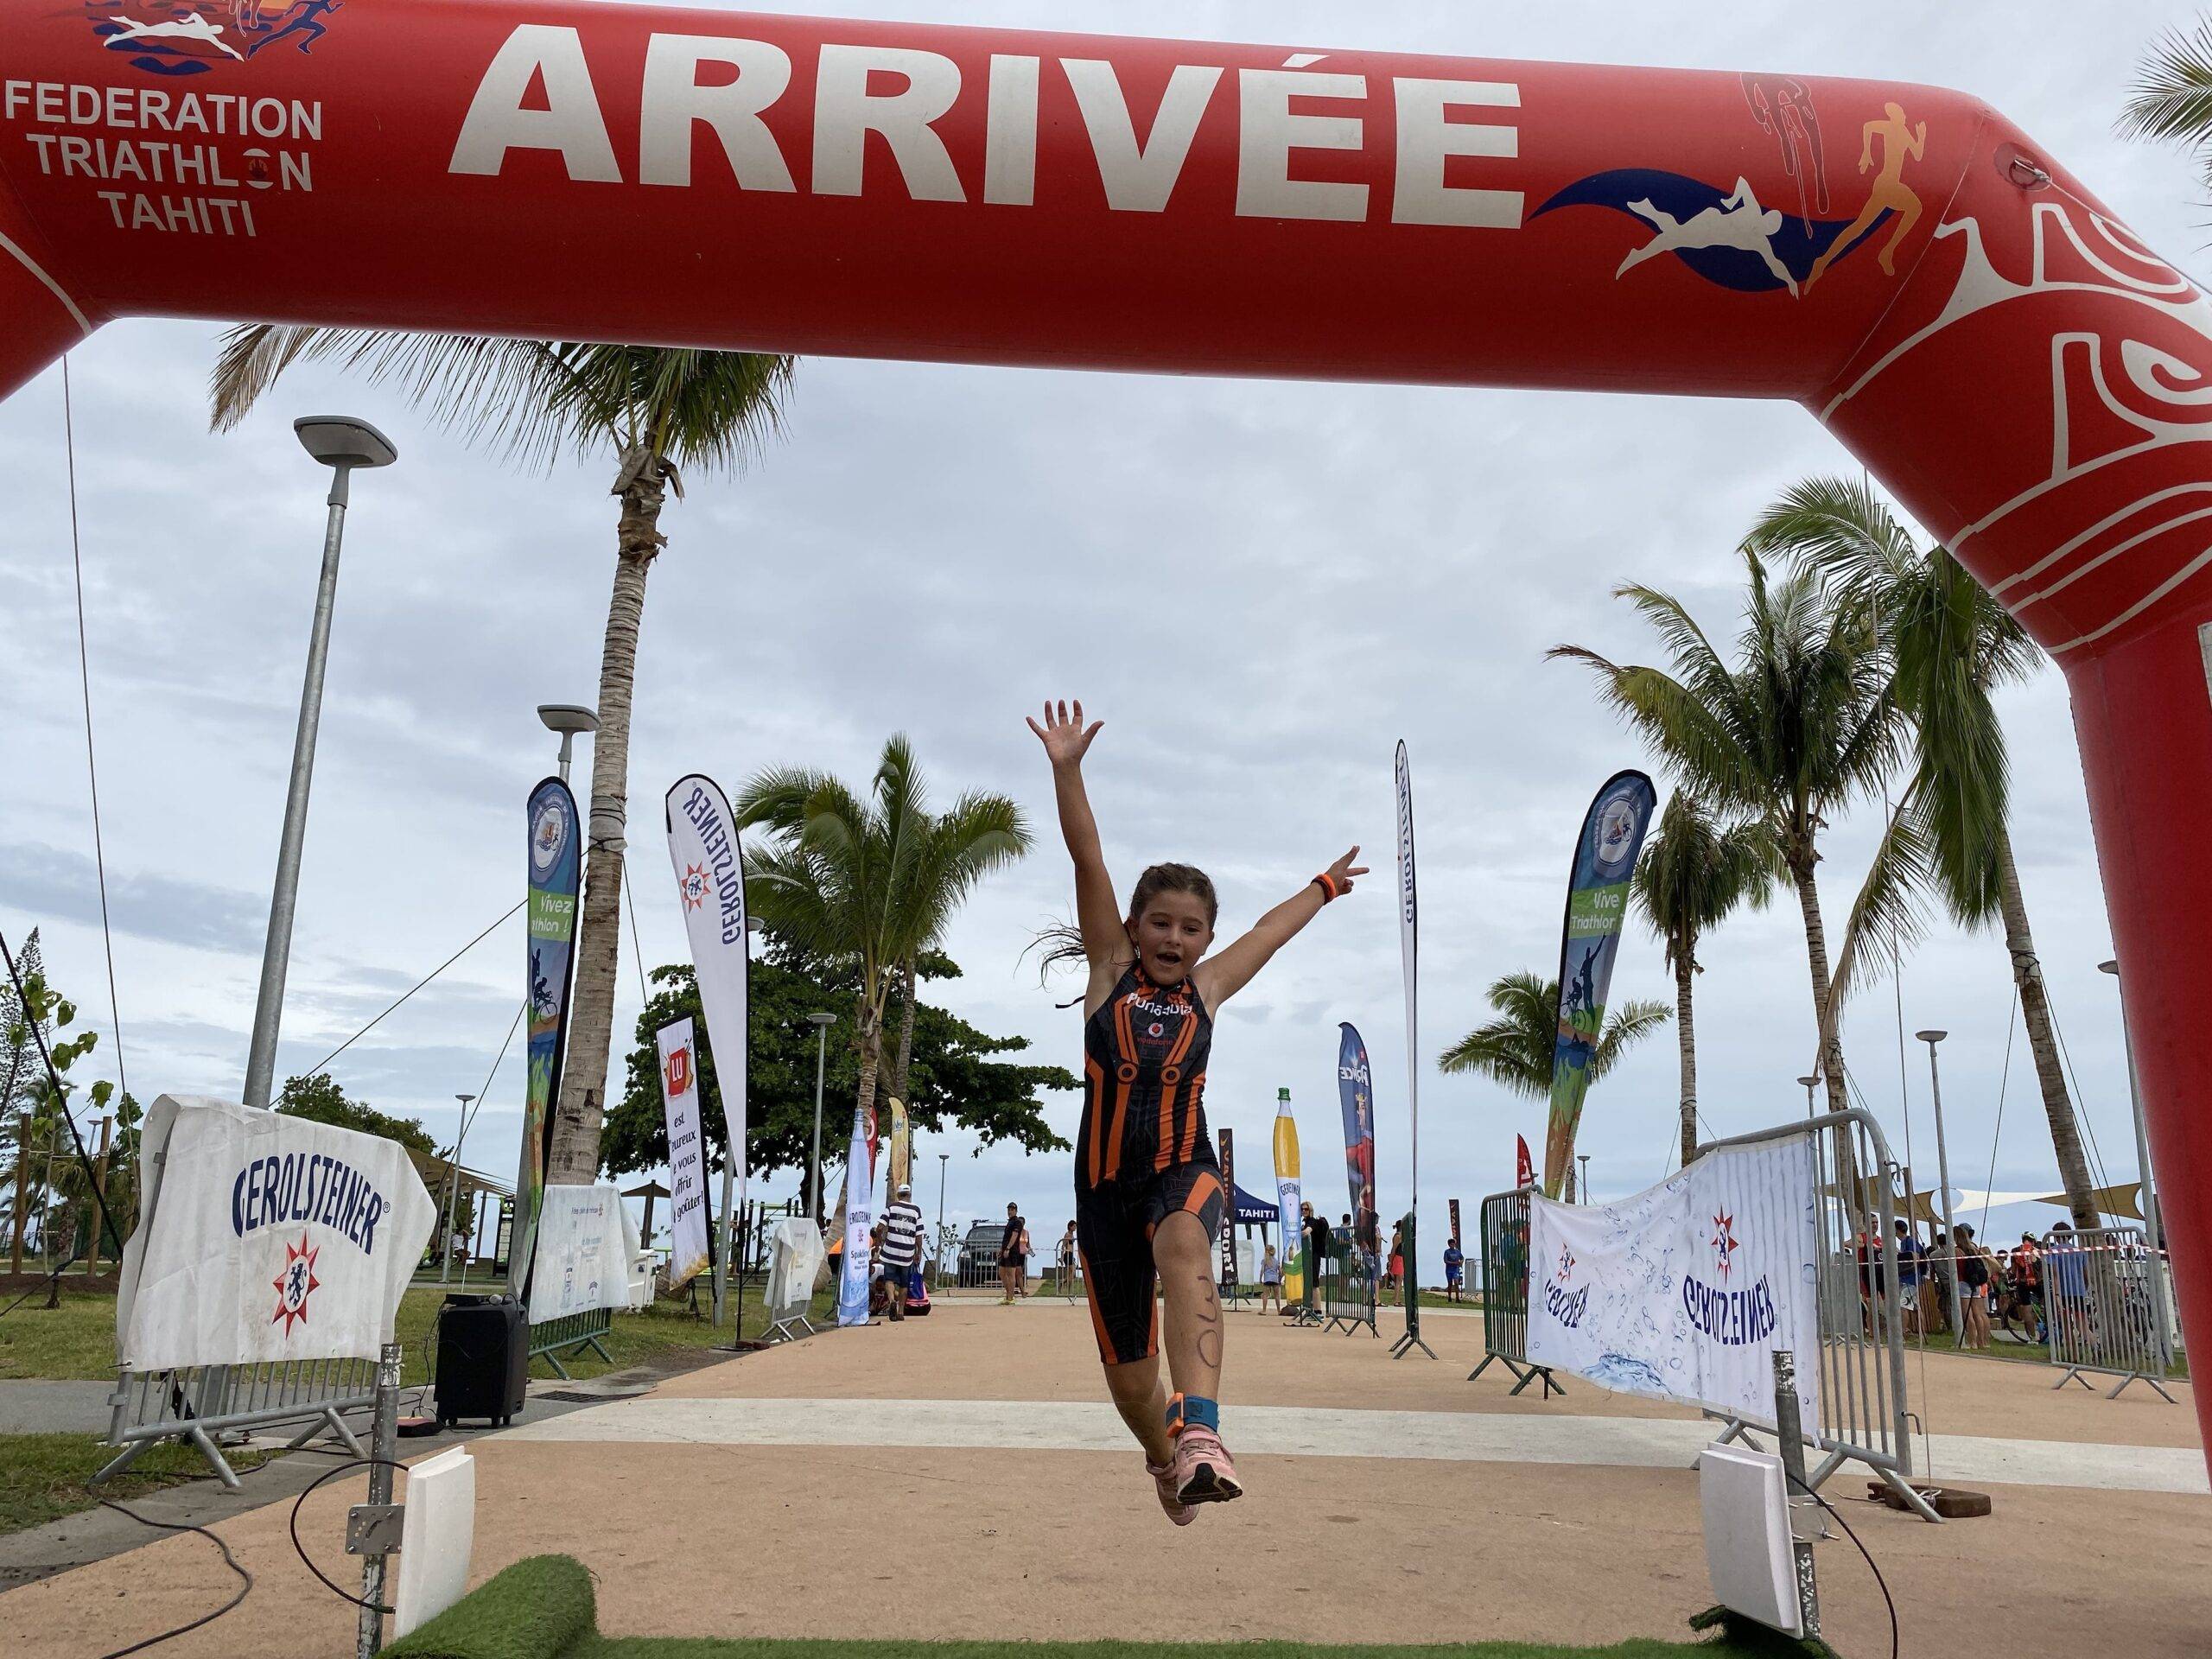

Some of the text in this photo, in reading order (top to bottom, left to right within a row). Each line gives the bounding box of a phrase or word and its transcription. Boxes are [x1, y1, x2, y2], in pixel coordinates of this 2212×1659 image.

[5, 79, 322, 141] FEDERATION
[447, 23, 1526, 229] ARRIVÉE
[26, 133, 313, 192] TRIATHLON
[97, 191, 257, 237] TAHITI
[541, 894, 572, 913] Vivez
[671, 1056, 683, 1082] LU
[674, 1112, 685, 1128] est
[678, 1152, 696, 1170] vous
[1238, 1209, 1274, 1218] TAHITI
